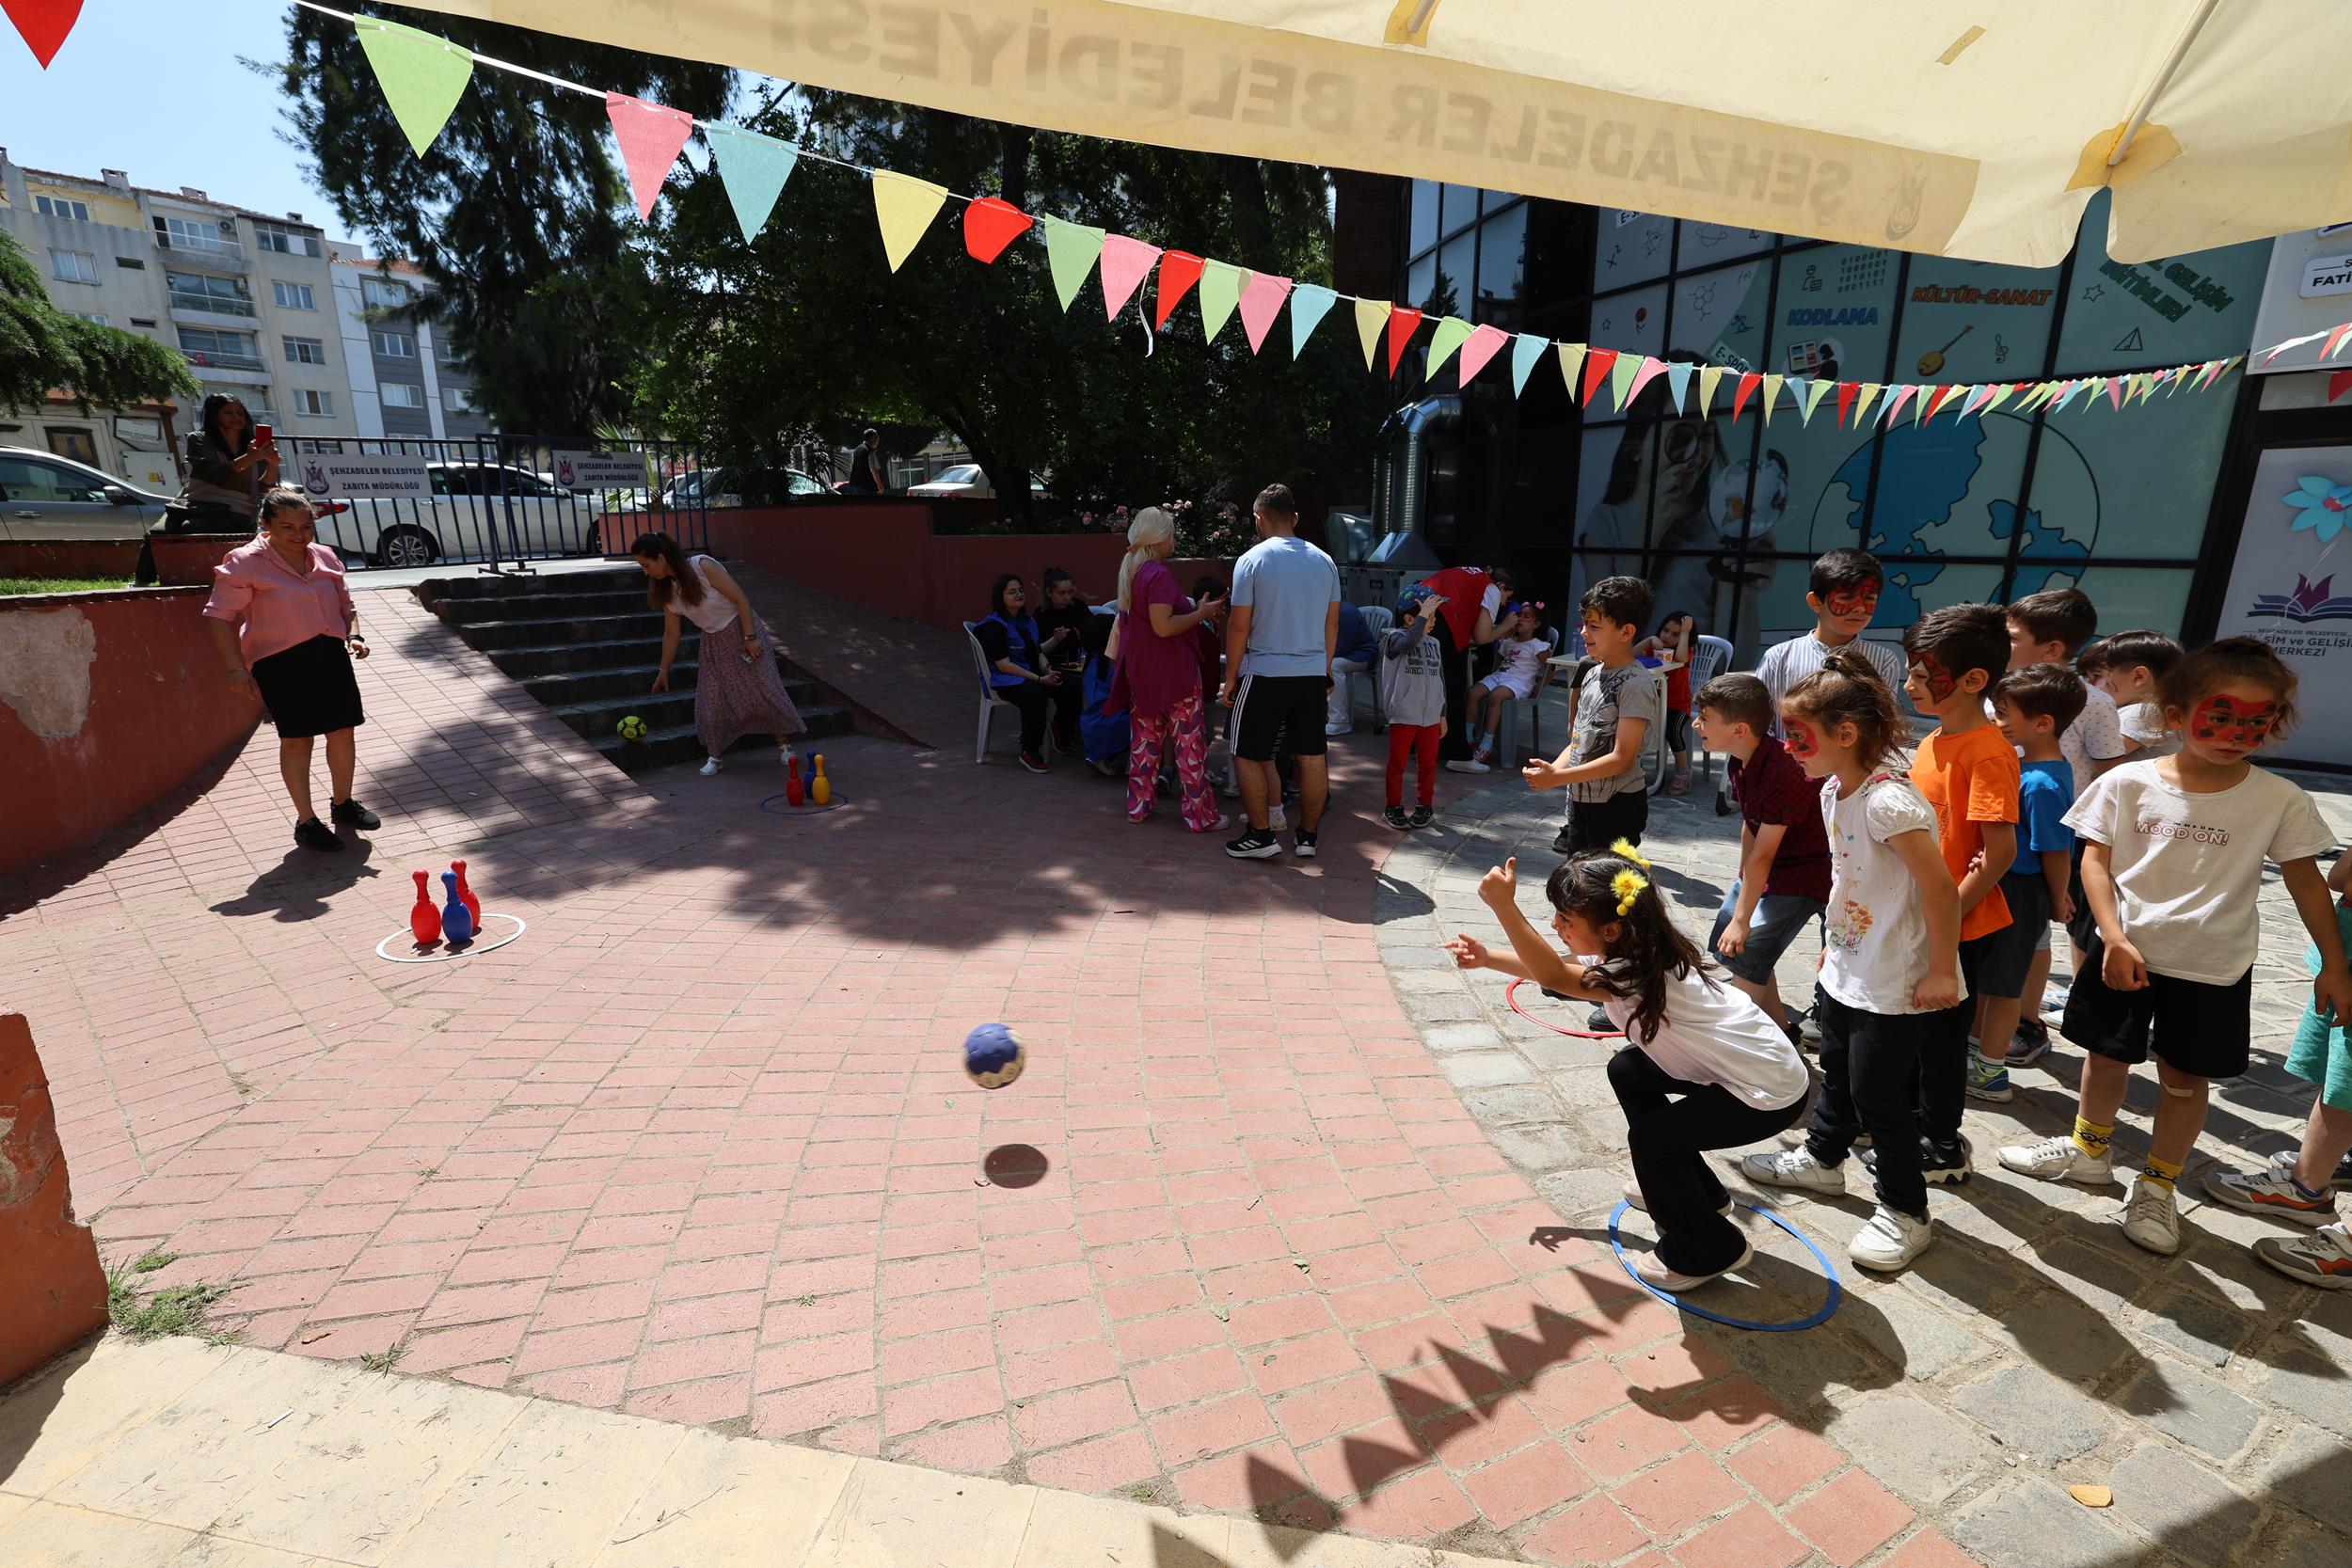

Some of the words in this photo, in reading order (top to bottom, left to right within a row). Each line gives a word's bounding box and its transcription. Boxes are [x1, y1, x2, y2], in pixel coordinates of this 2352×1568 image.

[2164, 262, 2234, 313] GELİŞİM
[2312, 271, 2352, 287] FATİ
[1911, 284, 2054, 306] KÜLTÜR-SANAT
[1787, 307, 1879, 326] KODLAMA
[329, 467, 381, 477] ŞEHZADELER
[382, 466, 425, 475] BELEDİYESİ
[372, 481, 420, 490] MÜDÜRLÜĞÜ
[2307, 637, 2352, 649] GELİŞİ
[2134, 820, 2189, 839] MOOD
[2193, 830, 2230, 847] ON!
